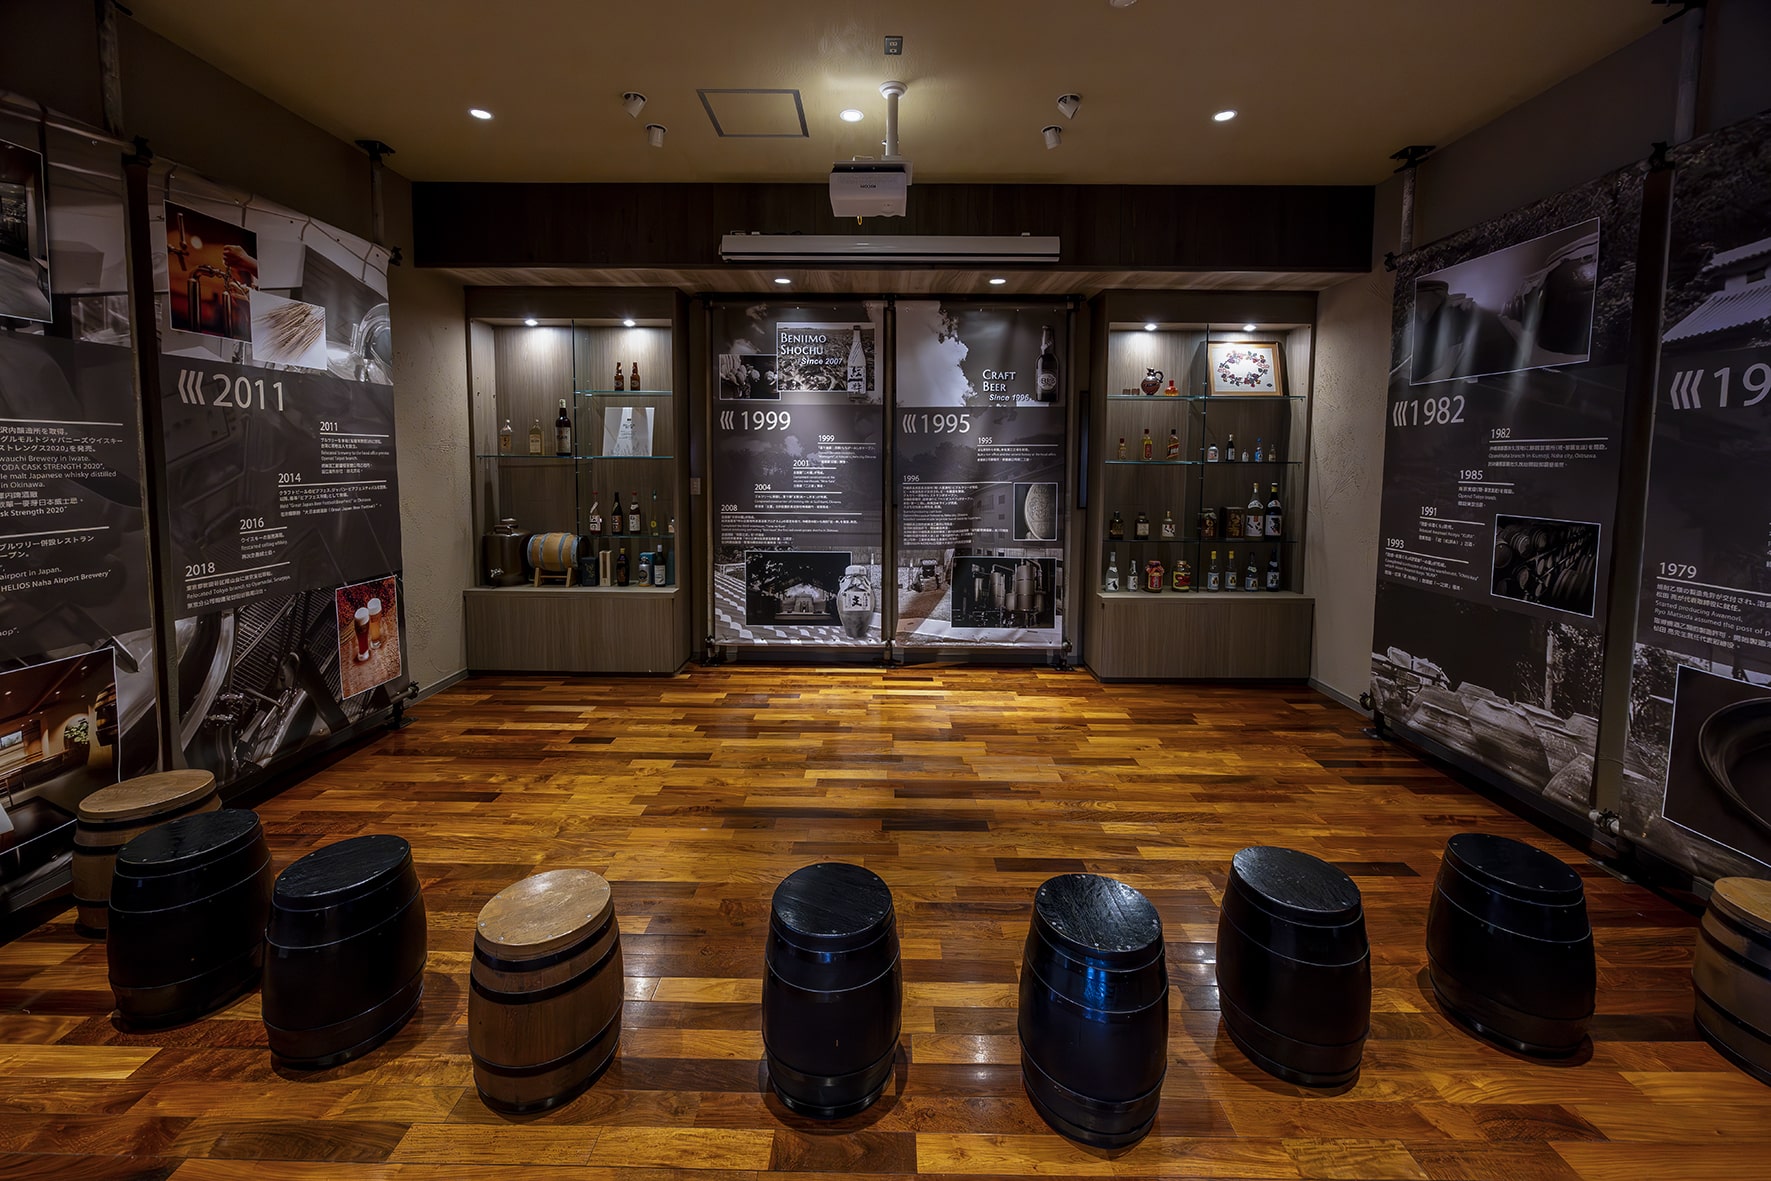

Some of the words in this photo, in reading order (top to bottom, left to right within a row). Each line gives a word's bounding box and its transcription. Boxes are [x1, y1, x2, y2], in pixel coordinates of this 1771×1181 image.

[780, 345, 823, 355] SHOCHU
[801, 357, 823, 365] Since
[982, 369, 1017, 381] CRAFT
[982, 381, 1007, 392] BEER
[212, 373, 284, 412] 2011
[1410, 394, 1466, 426] 1982
[741, 410, 792, 430] 1999
[920, 413, 971, 434] 1995
[320, 421, 338, 432] 2011
[818, 434, 835, 442] 1999
[1490, 428, 1511, 439] 1982
[977, 437, 993, 445] 1995
[28, 455, 58, 464] Brewery
[793, 459, 809, 467] 2001
[28, 472, 63, 481] Japanese
[65, 471, 89, 480] whisky
[278, 472, 301, 484] 2014
[903, 475, 920, 483] 1996
[1459, 470, 1484, 480] 1985
[10, 480, 45, 488] Okinawa.
[754, 483, 771, 491] 2004
[11, 507, 44, 517] Strength
[721, 504, 738, 512] 2008
[1421, 506, 1437, 517] 1991
[240, 517, 264, 530] 2016
[1387, 538, 1405, 549] 1993
[0, 572, 27, 581] airport
[38, 567, 62, 576] Japan.
[185, 562, 216, 578] 2018
[1659, 562, 1698, 580] 1979
[1, 581, 31, 592] HELIOS
[32, 579, 52, 588] Naha
[53, 575, 79, 586] Airport
[1655, 600, 1678, 610] Started
[1679, 604, 1710, 617] producing
[1654, 608, 1667, 616] Ryo
[1667, 609, 1694, 621] Matsuda
[1694, 616, 1722, 627] assumed
[1723, 621, 1735, 630] the
[1736, 625, 1753, 634] post
[1754, 627, 1764, 635] of
